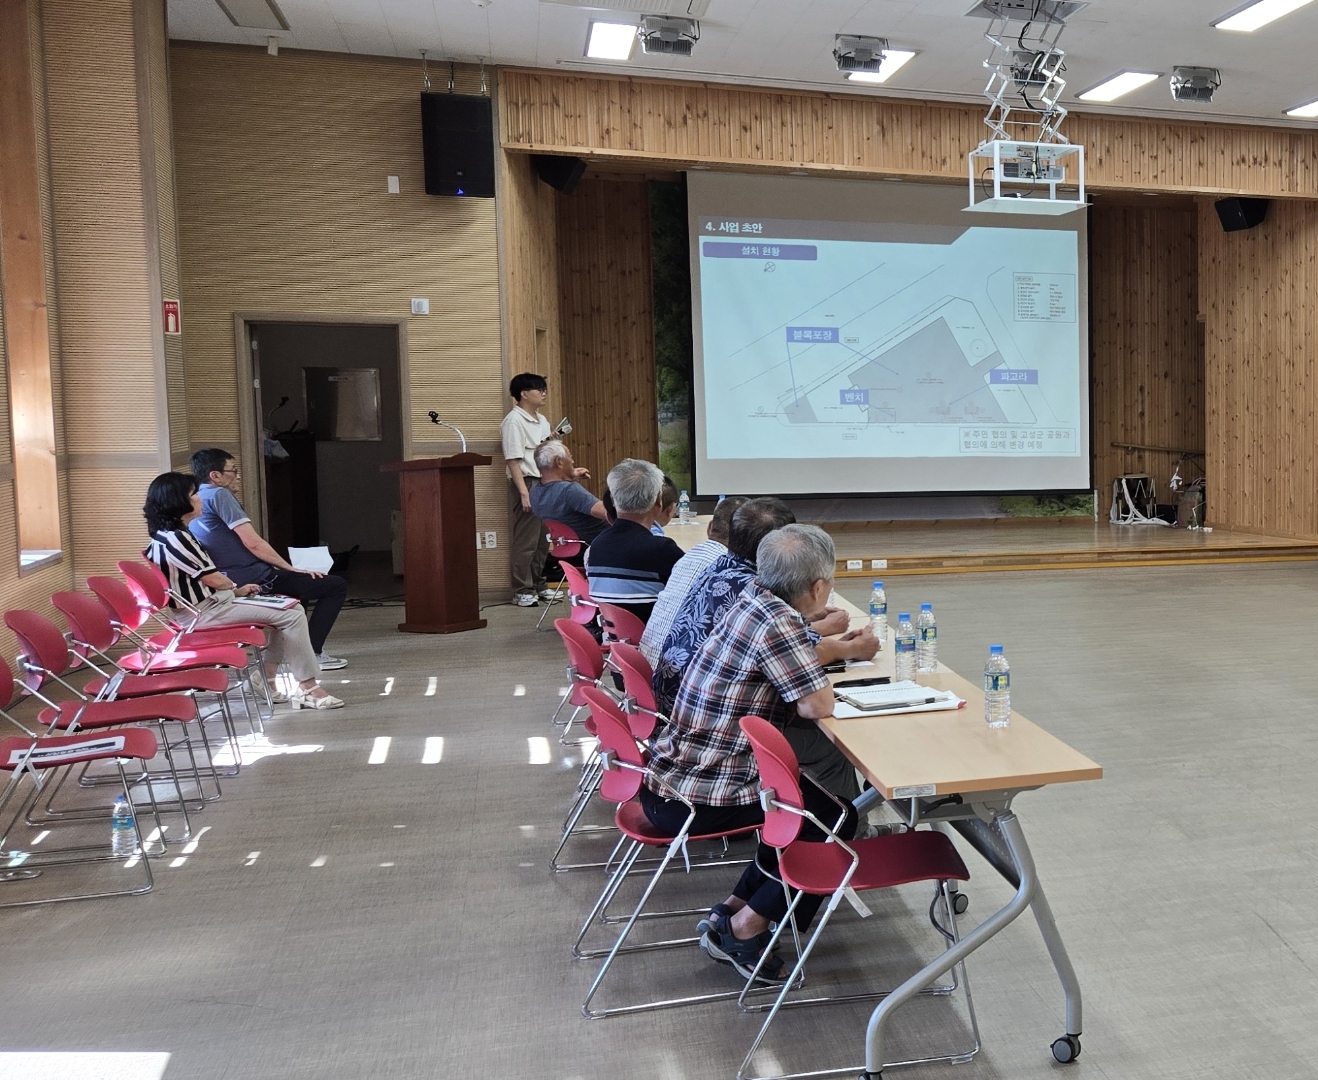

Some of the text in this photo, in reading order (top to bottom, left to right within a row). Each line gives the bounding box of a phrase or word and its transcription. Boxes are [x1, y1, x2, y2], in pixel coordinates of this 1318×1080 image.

[705, 221, 763, 234] 4. 사업 초안
[741, 246, 780, 257] 설치 현황
[793, 330, 832, 341] 블록포장
[1000, 372, 1027, 382] 파고라
[844, 392, 864, 403] 벤치
[972, 430, 989, 439] 주민
[991, 430, 1007, 439] 협의
[1010, 430, 1018, 440] 및
[1020, 430, 1044, 440] 고성군
[963, 440, 1043, 450] 협의에 의해 변경 예정
